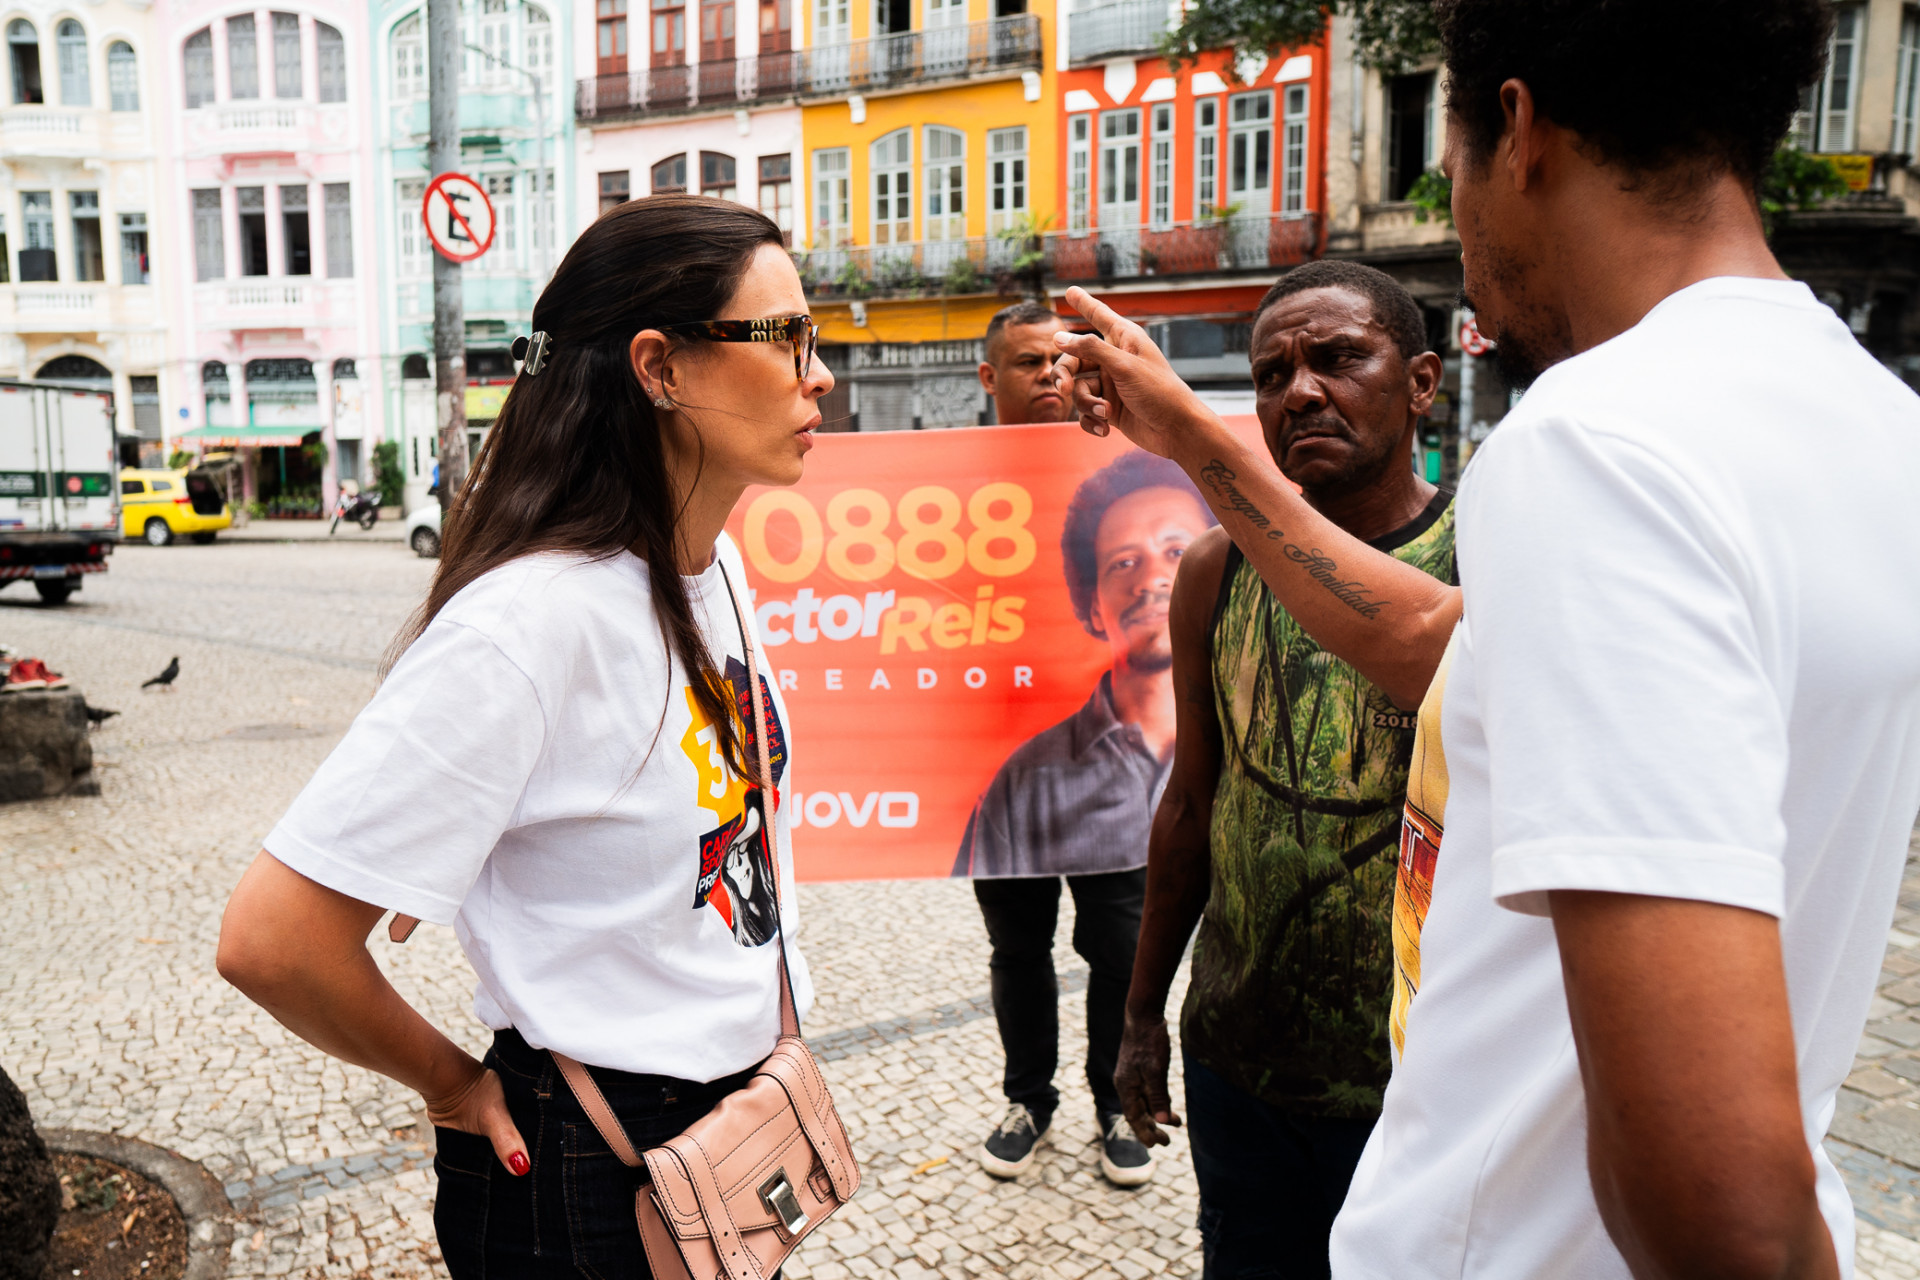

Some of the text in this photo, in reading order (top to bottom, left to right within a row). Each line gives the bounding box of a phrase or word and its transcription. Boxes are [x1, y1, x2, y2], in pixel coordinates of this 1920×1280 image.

[727, 482, 1037, 583] 0888
[1267, 529, 1285, 541] e
[880, 584, 1027, 655] Reis
